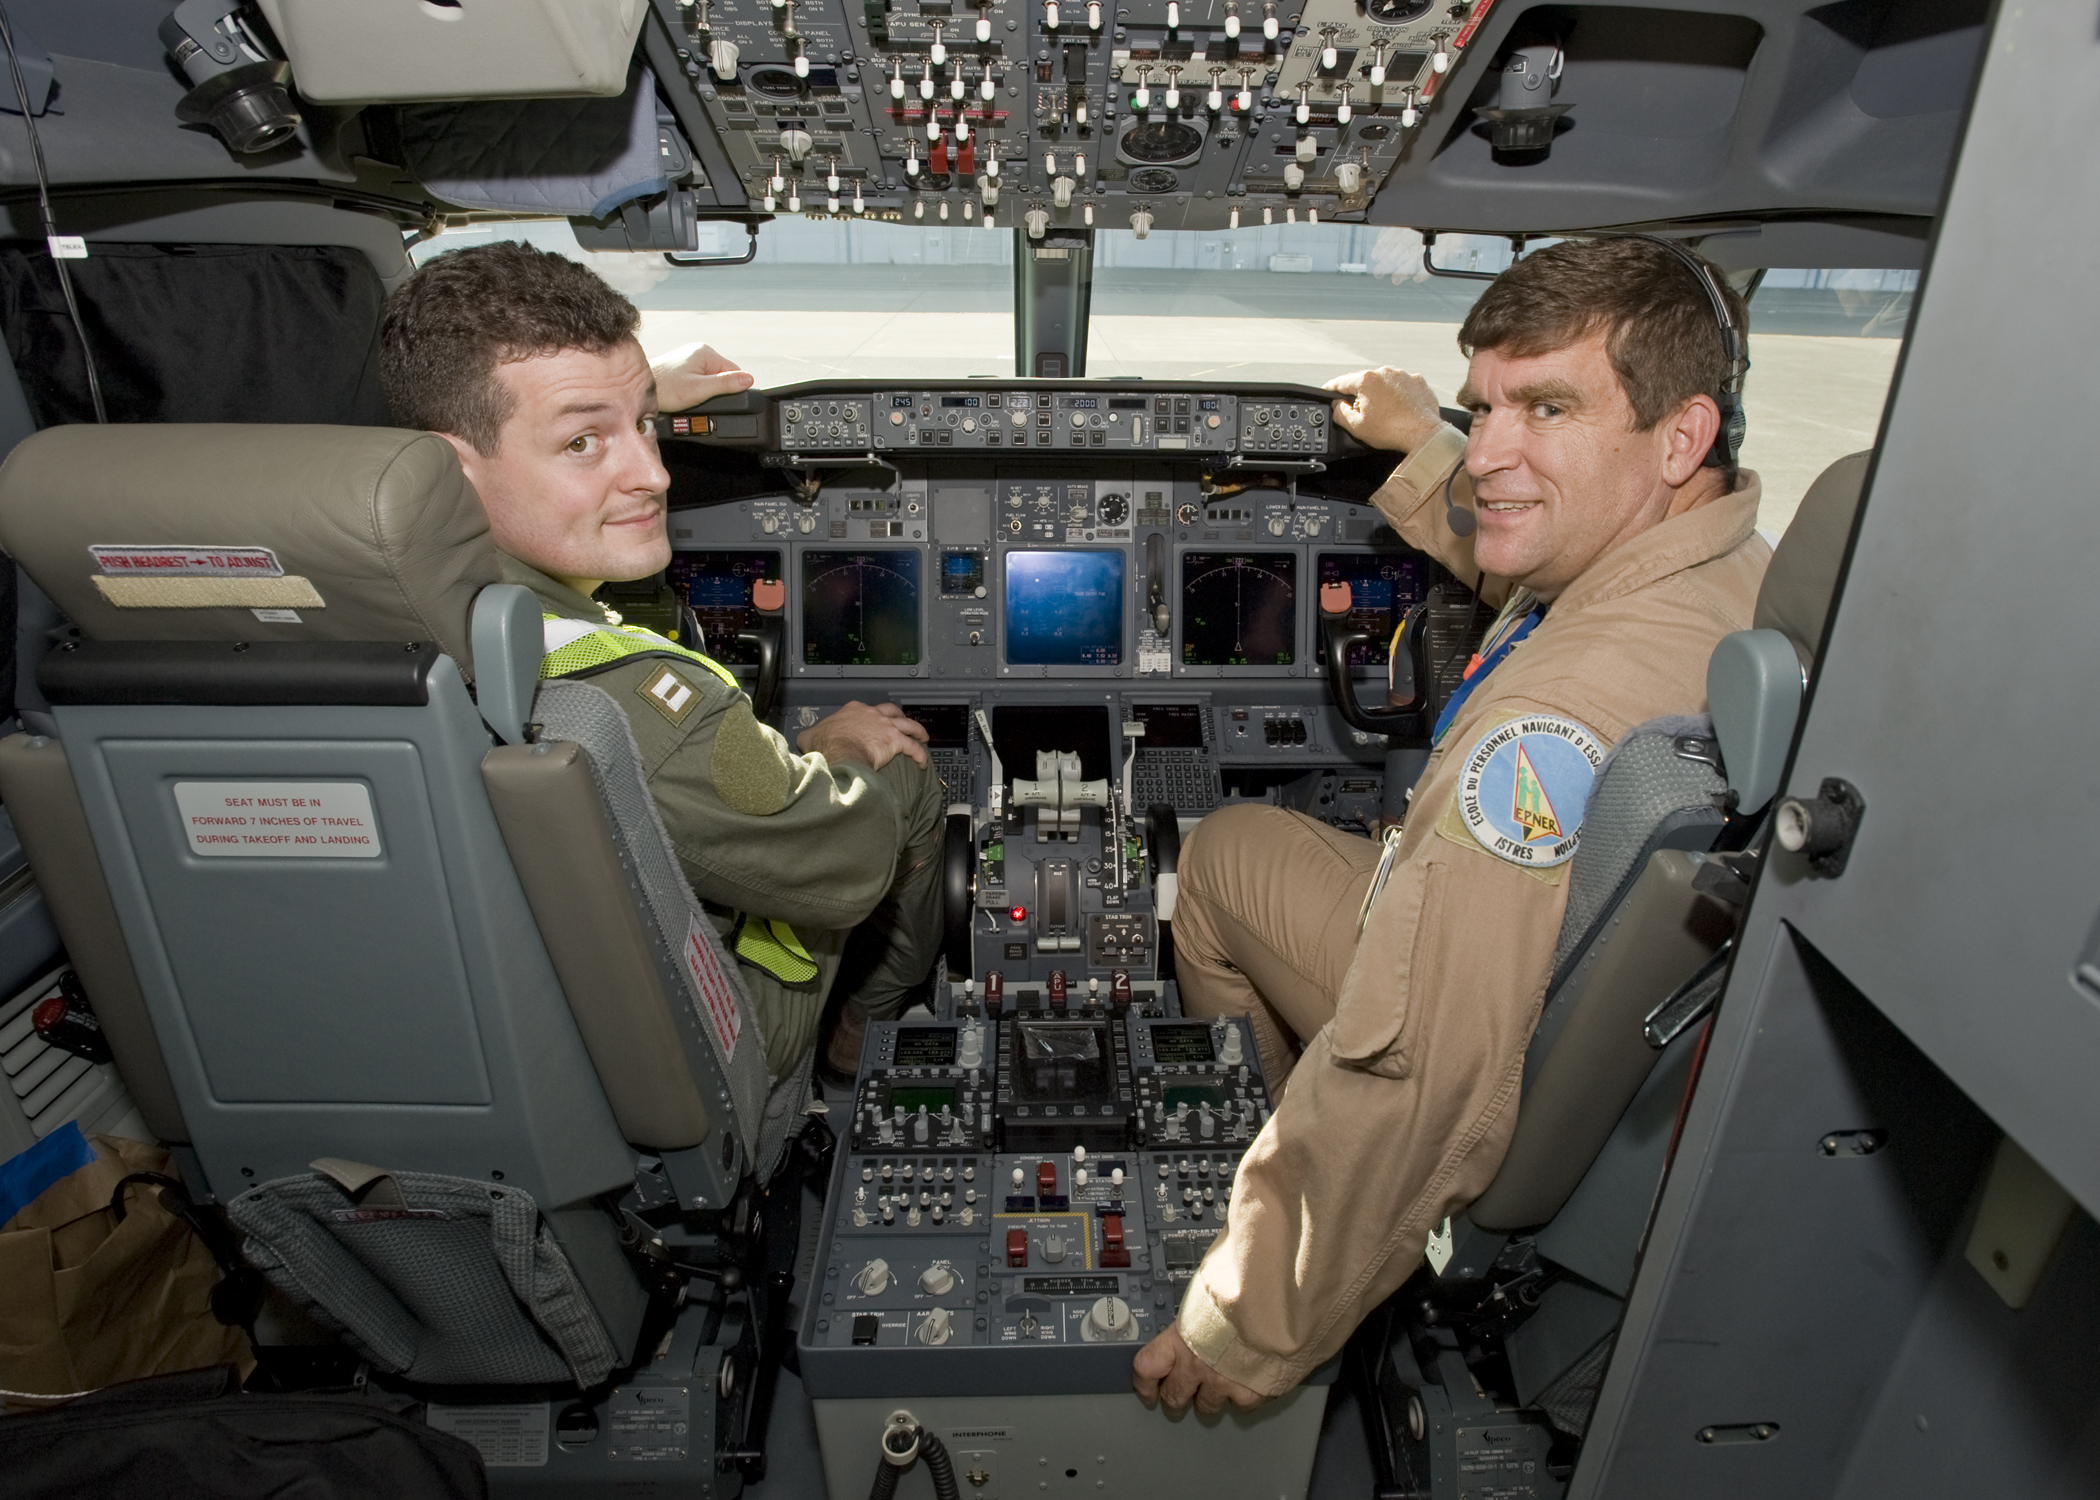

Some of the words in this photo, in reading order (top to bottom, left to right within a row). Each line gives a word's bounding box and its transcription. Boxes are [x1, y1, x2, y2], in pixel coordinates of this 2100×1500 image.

[1010, 399, 1028, 407] 222
[100, 556, 130, 568] PUSH
[133, 556, 190, 568] HEADREST
[207, 557, 224, 567] TO
[228, 557, 272, 568] ADJUST
[1522, 722, 1577, 739] NAVIGANT
[1470, 727, 1518, 773] PERSONNEL
[1033, 783, 1038, 791] 1
[1467, 779, 1478, 790] DU
[225, 798, 254, 807] SEAT
[257, 798, 287, 807] MUST
[292, 798, 307, 807] BE
[310, 798, 321, 807] IN
[1465, 795, 1484, 827] ECOLE
[192, 817, 247, 826] FORWARD
[251, 817, 256, 825] 7
[259, 817, 300, 826] INCHES
[304, 817, 318, 826] OF
[322, 817, 363, 826] TRAVEL
[1516, 808, 1557, 833] EPNER
[196, 835, 239, 844] DURING
[243, 835, 290, 844] TAKEOFF
[294, 835, 317, 844] AND
[321, 835, 370, 845] LANDING
[1494, 837, 1533, 860] ISTRES
[990, 975, 998, 985] 1
[1115, 974, 1128, 989] 2
[952, 1430, 1006, 1438] INTERPHONE
